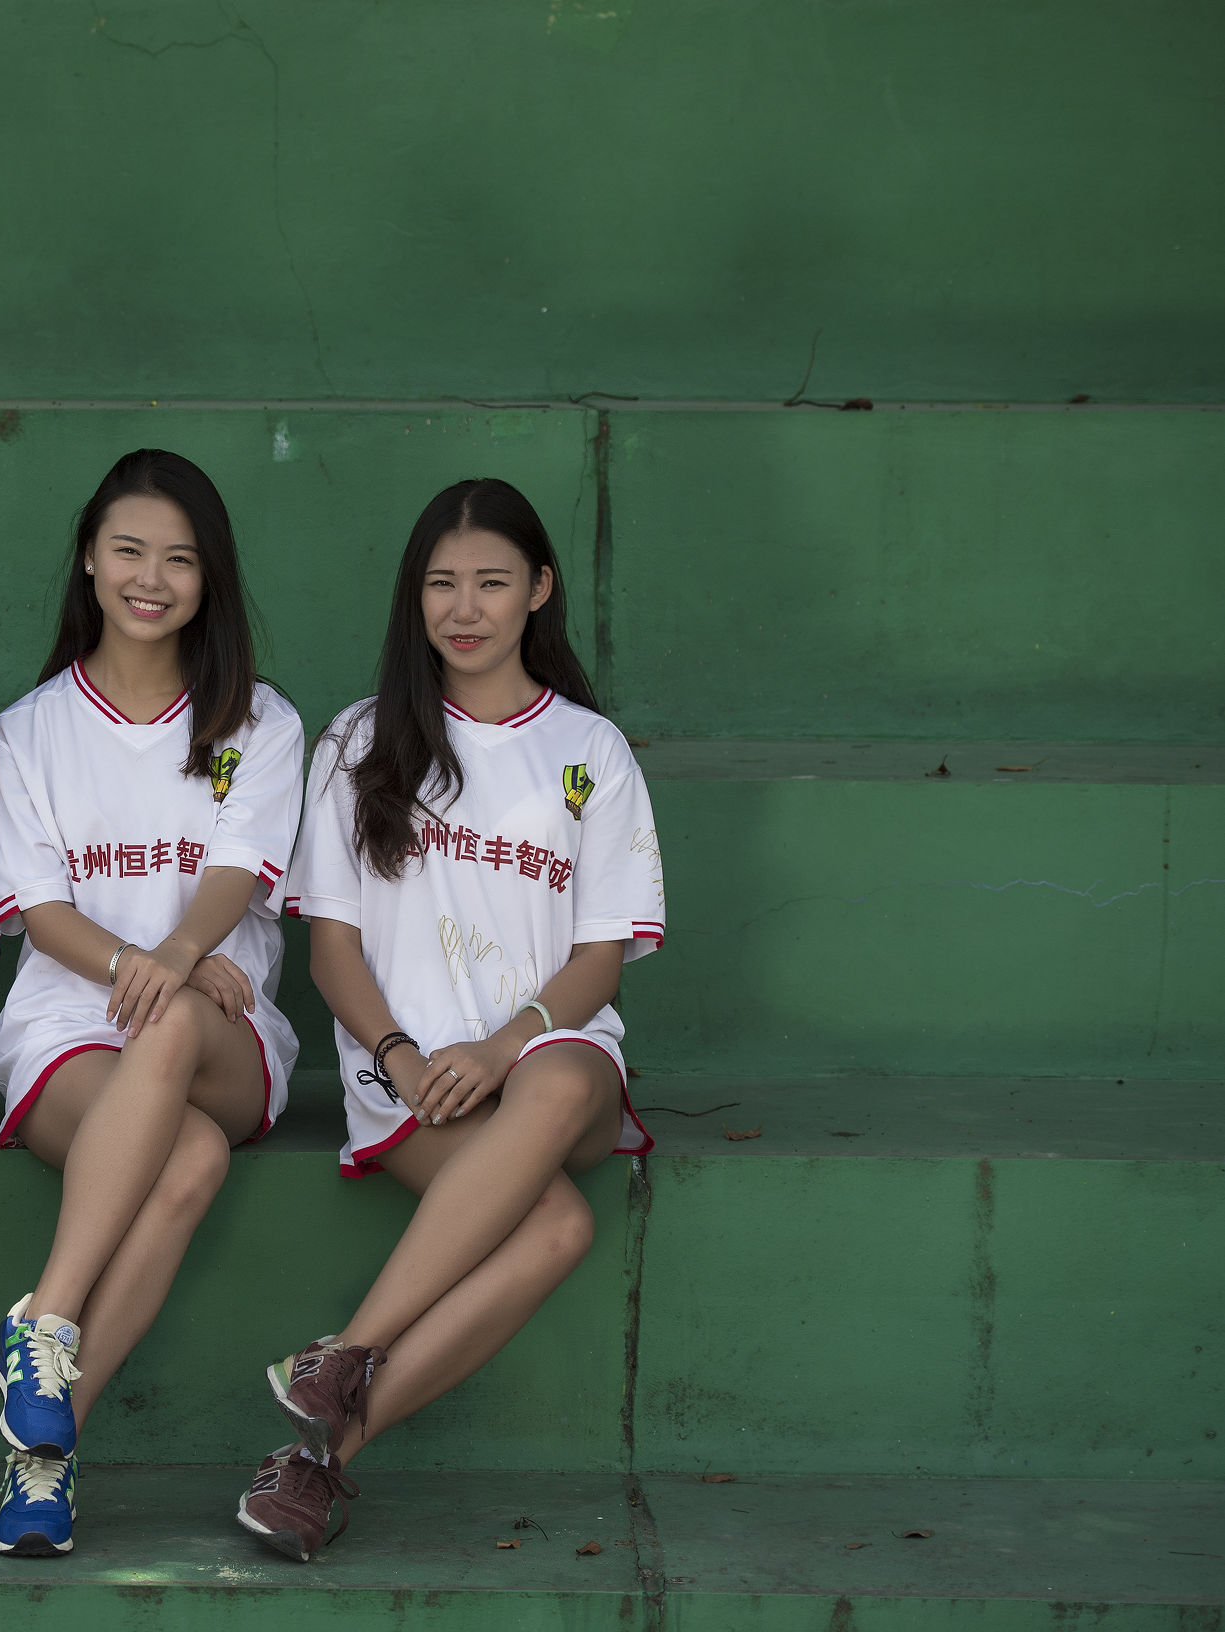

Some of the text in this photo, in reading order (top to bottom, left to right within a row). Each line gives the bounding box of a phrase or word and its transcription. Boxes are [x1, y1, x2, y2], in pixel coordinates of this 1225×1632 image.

[402, 820, 572, 894] 州恒丰智诚
